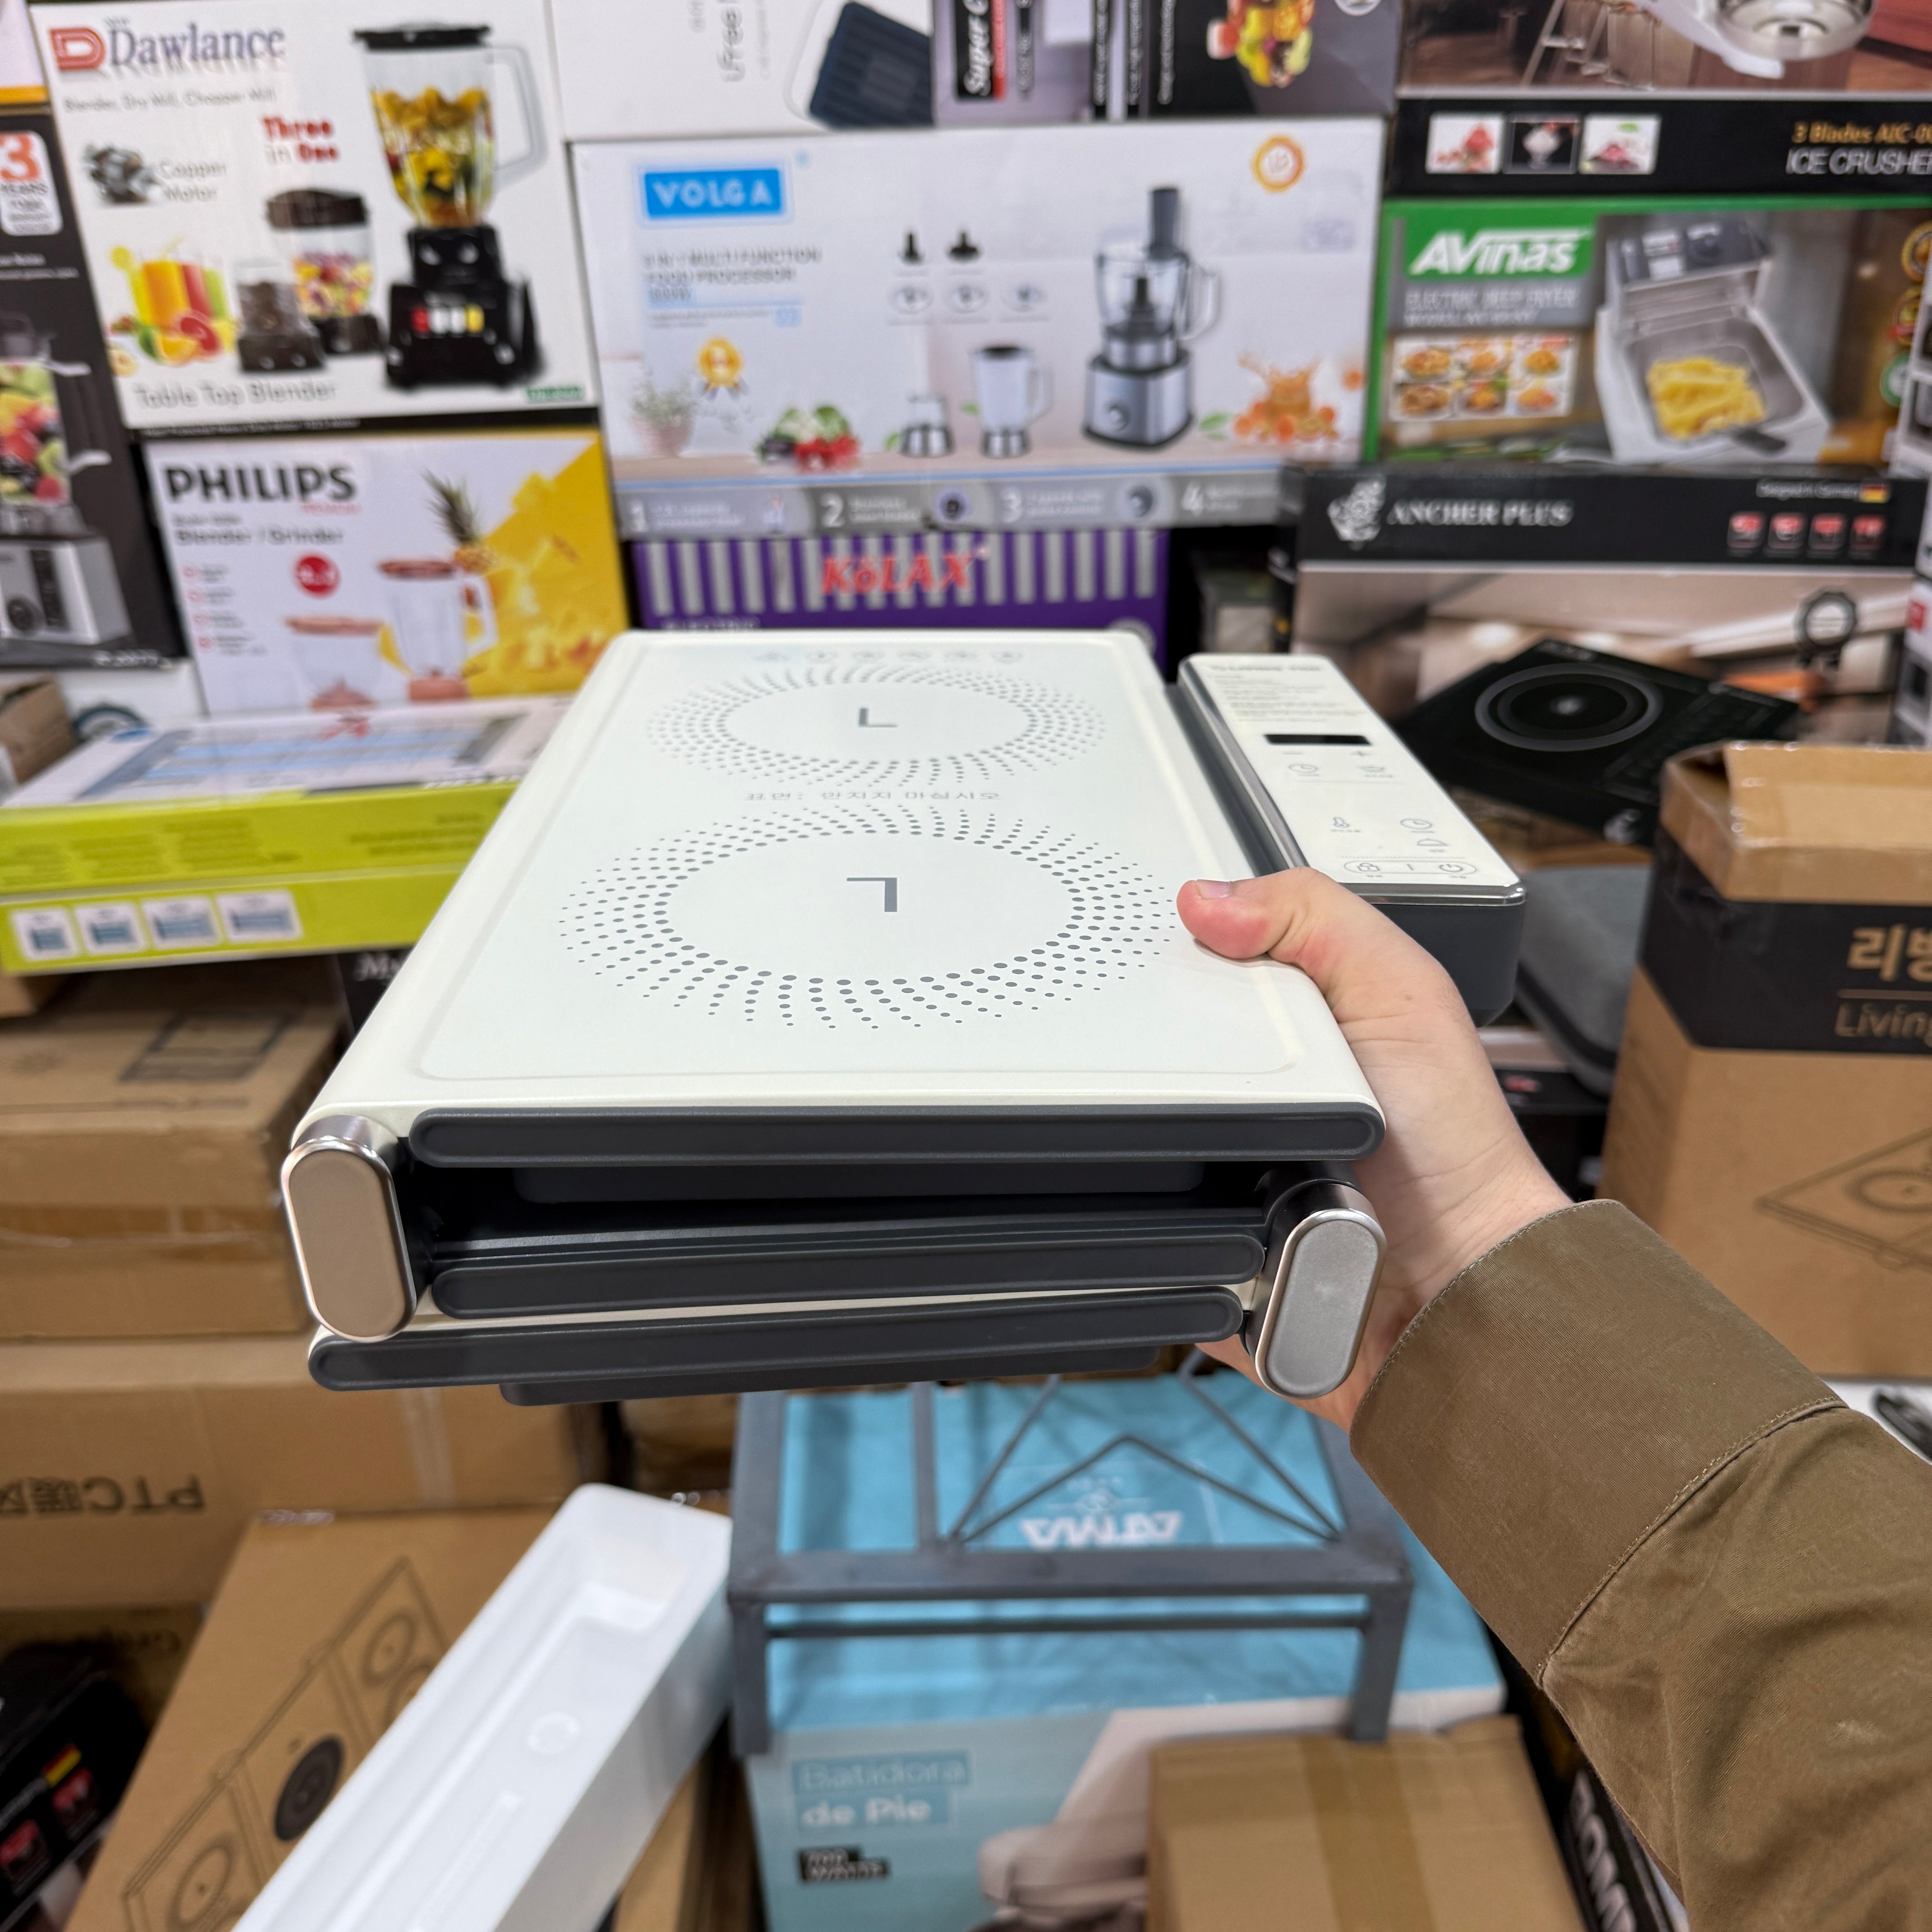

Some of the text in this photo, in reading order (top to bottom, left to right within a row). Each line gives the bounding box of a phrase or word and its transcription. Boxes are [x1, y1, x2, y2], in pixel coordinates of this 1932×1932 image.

[109, 23, 285, 67] Dawlance
[964, 16, 991, 96] Super
[262, 116, 333, 139] Three
[1808, 121, 1872, 144] Blades
[0, 133, 40, 182] 3
[1785, 148, 1828, 175] ICE
[652, 179, 774, 209] VOLGA
[249, 378, 337, 404] Blender
[165, 465, 356, 503] PHILIPS
[821, 494, 845, 528] 2
[1503, 499, 1574, 527] PLUS
[802, 1759, 964, 1790] Batidora
[802, 1793, 932, 1828] de Pie
